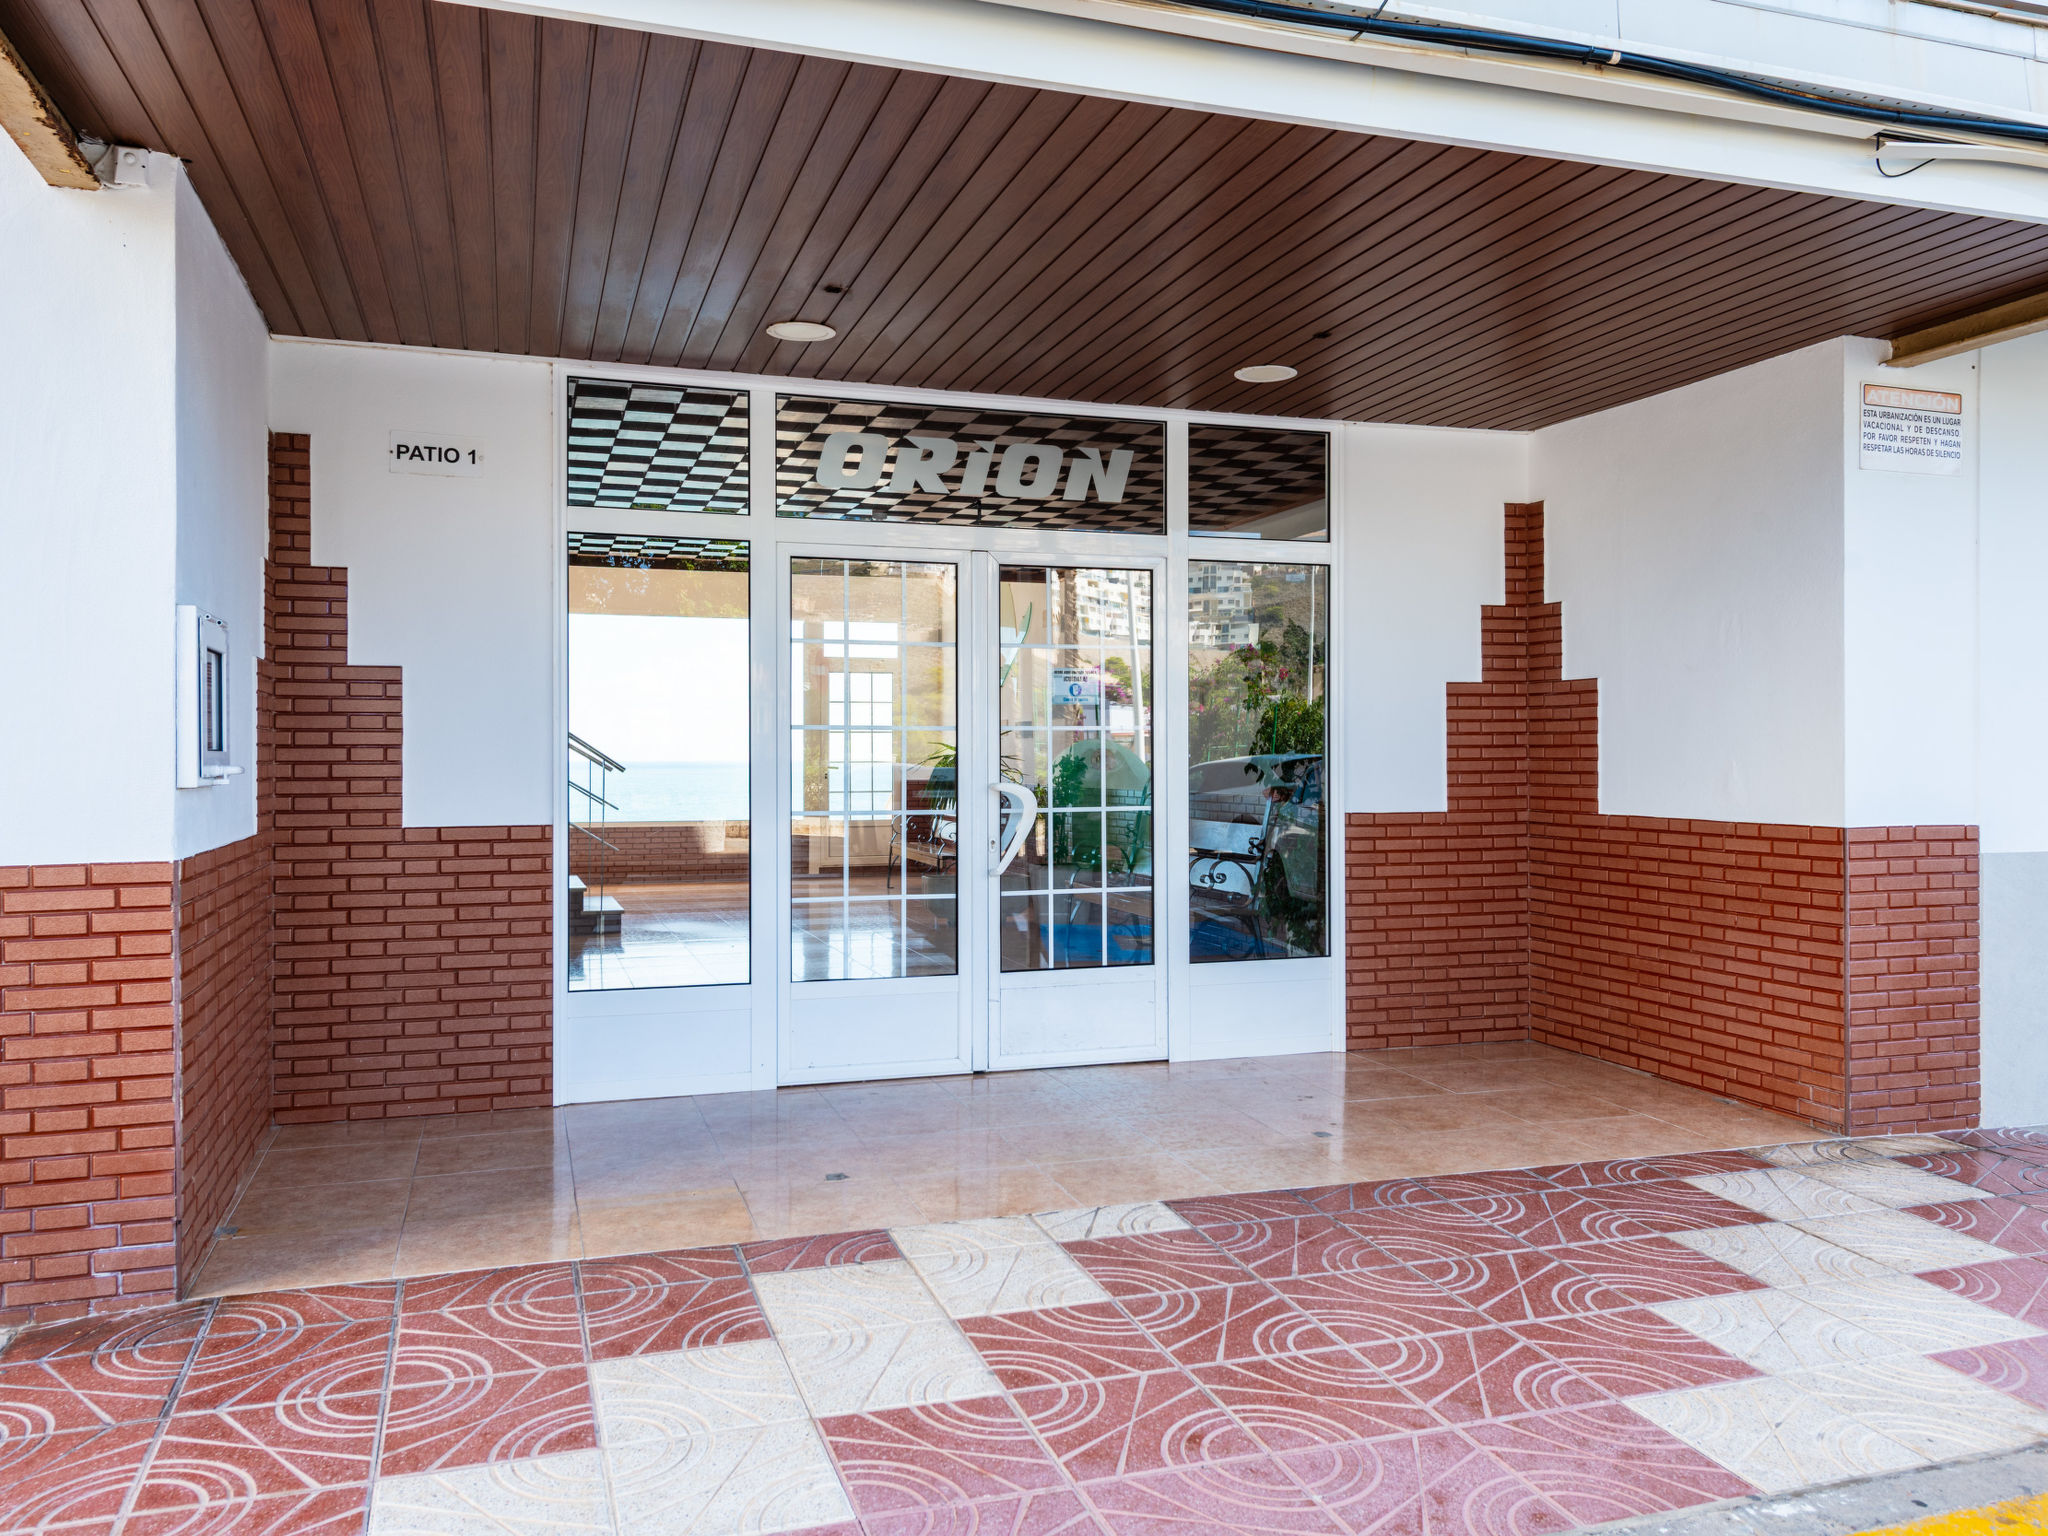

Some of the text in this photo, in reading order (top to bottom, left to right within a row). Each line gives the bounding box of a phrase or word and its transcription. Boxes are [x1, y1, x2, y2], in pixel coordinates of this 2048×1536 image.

[1867, 389, 1959, 411] ATENCIÓN
[1863, 409, 1961, 426] ESTA URBANIZACIÓN ES UN LUGAR
[1863, 420, 1904, 432] VACACIONAL
[1907, 425, 1912, 433] Y
[1914, 425, 1923, 433] DE
[1863, 431, 1961, 448] POR FAVOR RESPETEN Y HAGAN
[396, 444, 476, 465] PATIO 1
[1863, 443, 1961, 460] RESPETAR LAS HORAS DE SILENCIO
